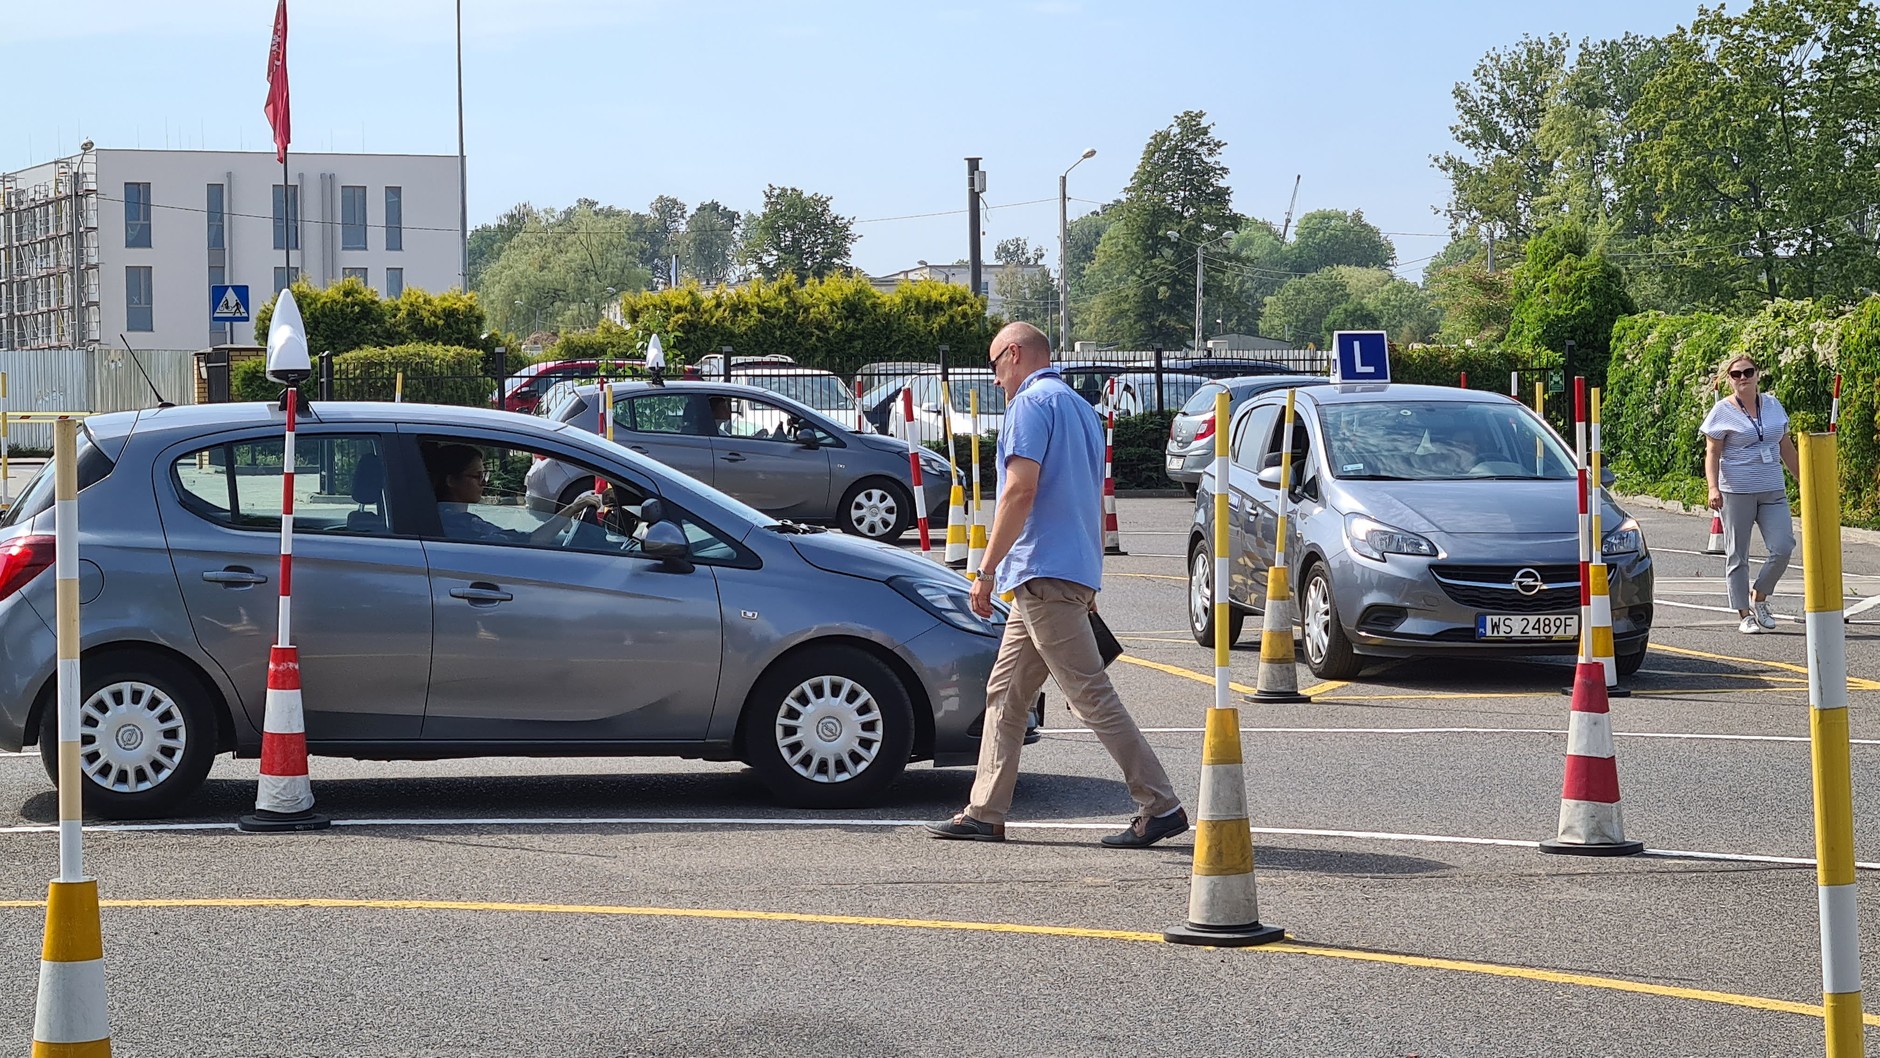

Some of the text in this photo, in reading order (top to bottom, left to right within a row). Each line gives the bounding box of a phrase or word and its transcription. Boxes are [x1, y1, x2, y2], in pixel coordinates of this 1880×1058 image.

[1353, 340, 1375, 373] L
[1490, 617, 1574, 635] WS 2489F
